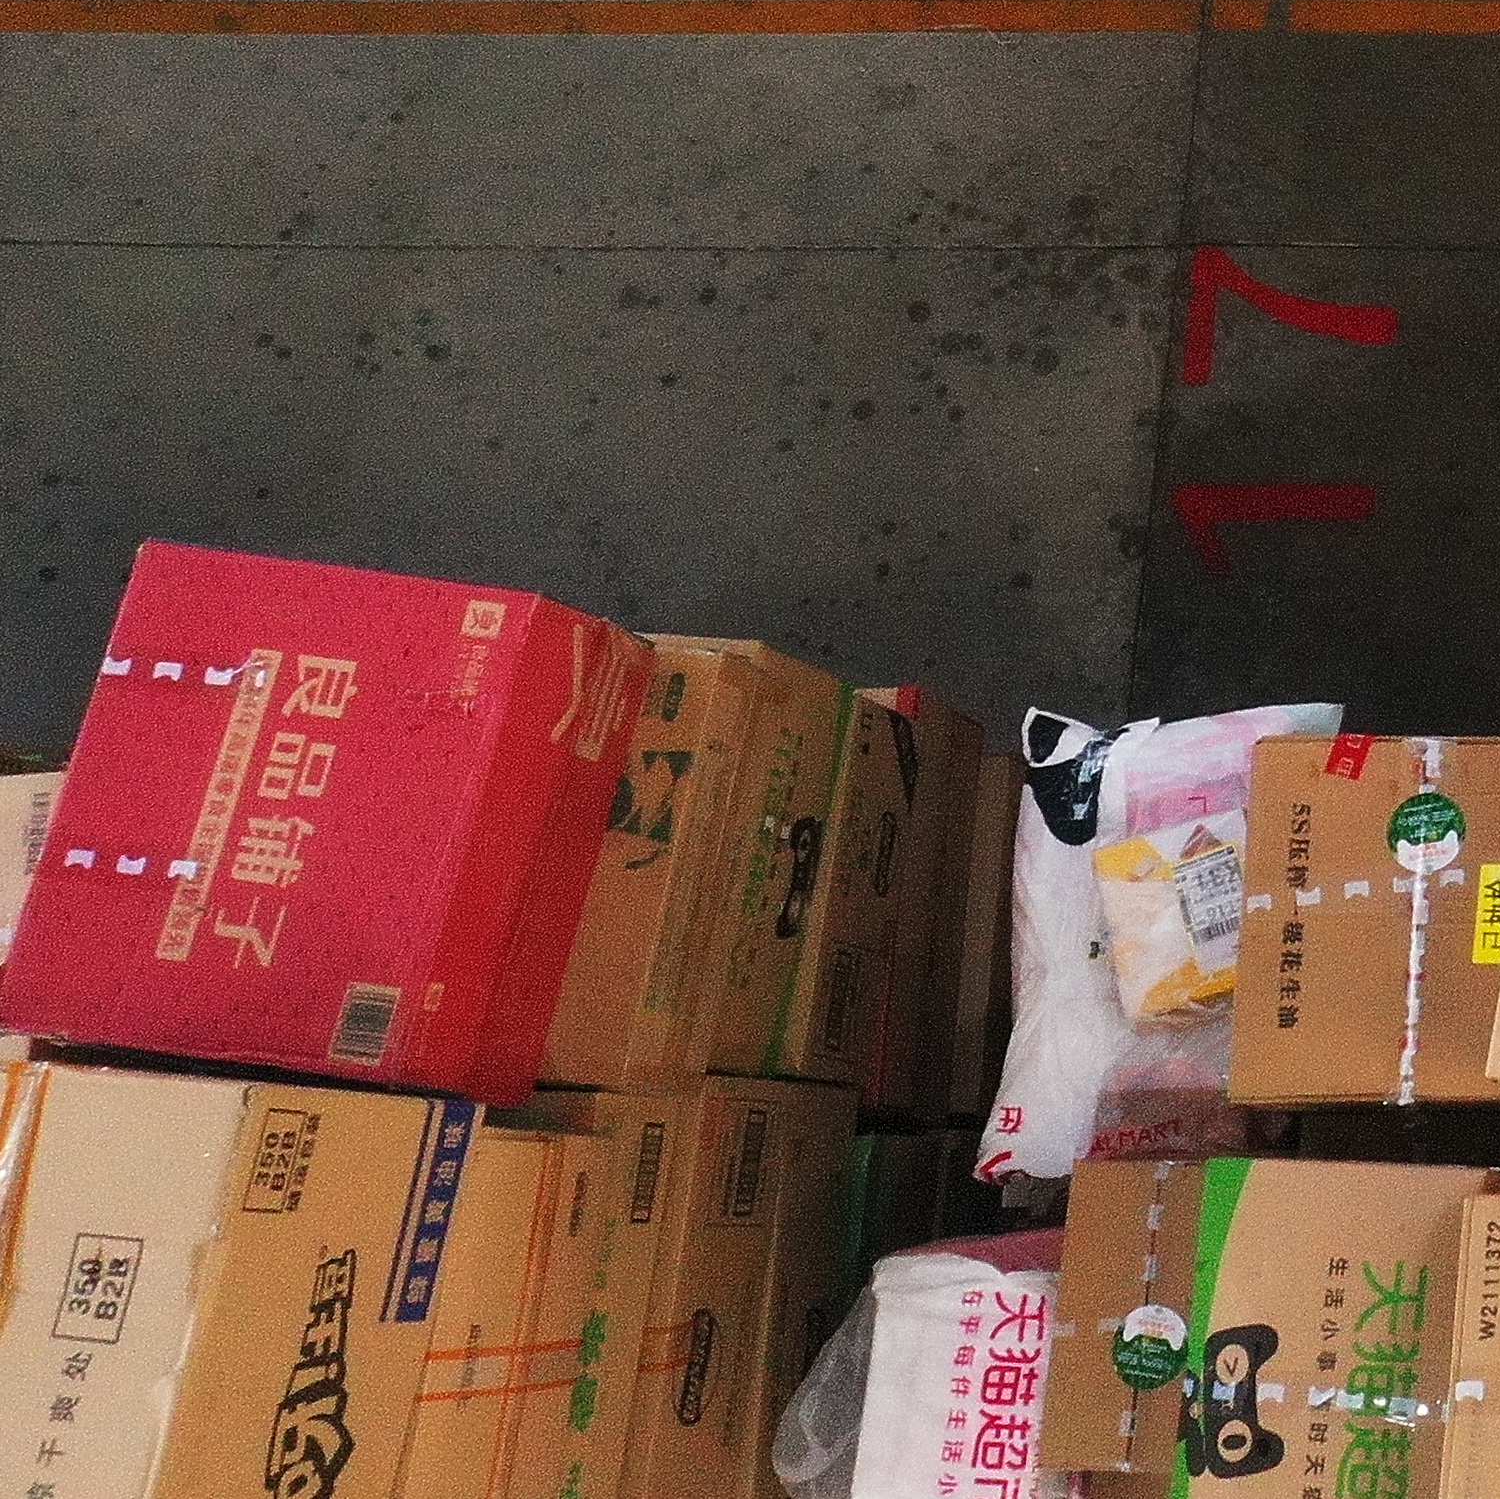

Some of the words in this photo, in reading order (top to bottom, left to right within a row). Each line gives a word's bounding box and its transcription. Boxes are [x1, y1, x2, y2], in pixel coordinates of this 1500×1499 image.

[212, 654, 358, 969] 良品铺子
[257, 1131, 281, 1191] 350
[275, 1129, 302, 1190] B2B
[408, 1114, 470, 1306] 蜂蜜黄油味
[70, 1256, 104, 1316] 350
[938, 1291, 986, 1499] 在乎每件生活小
